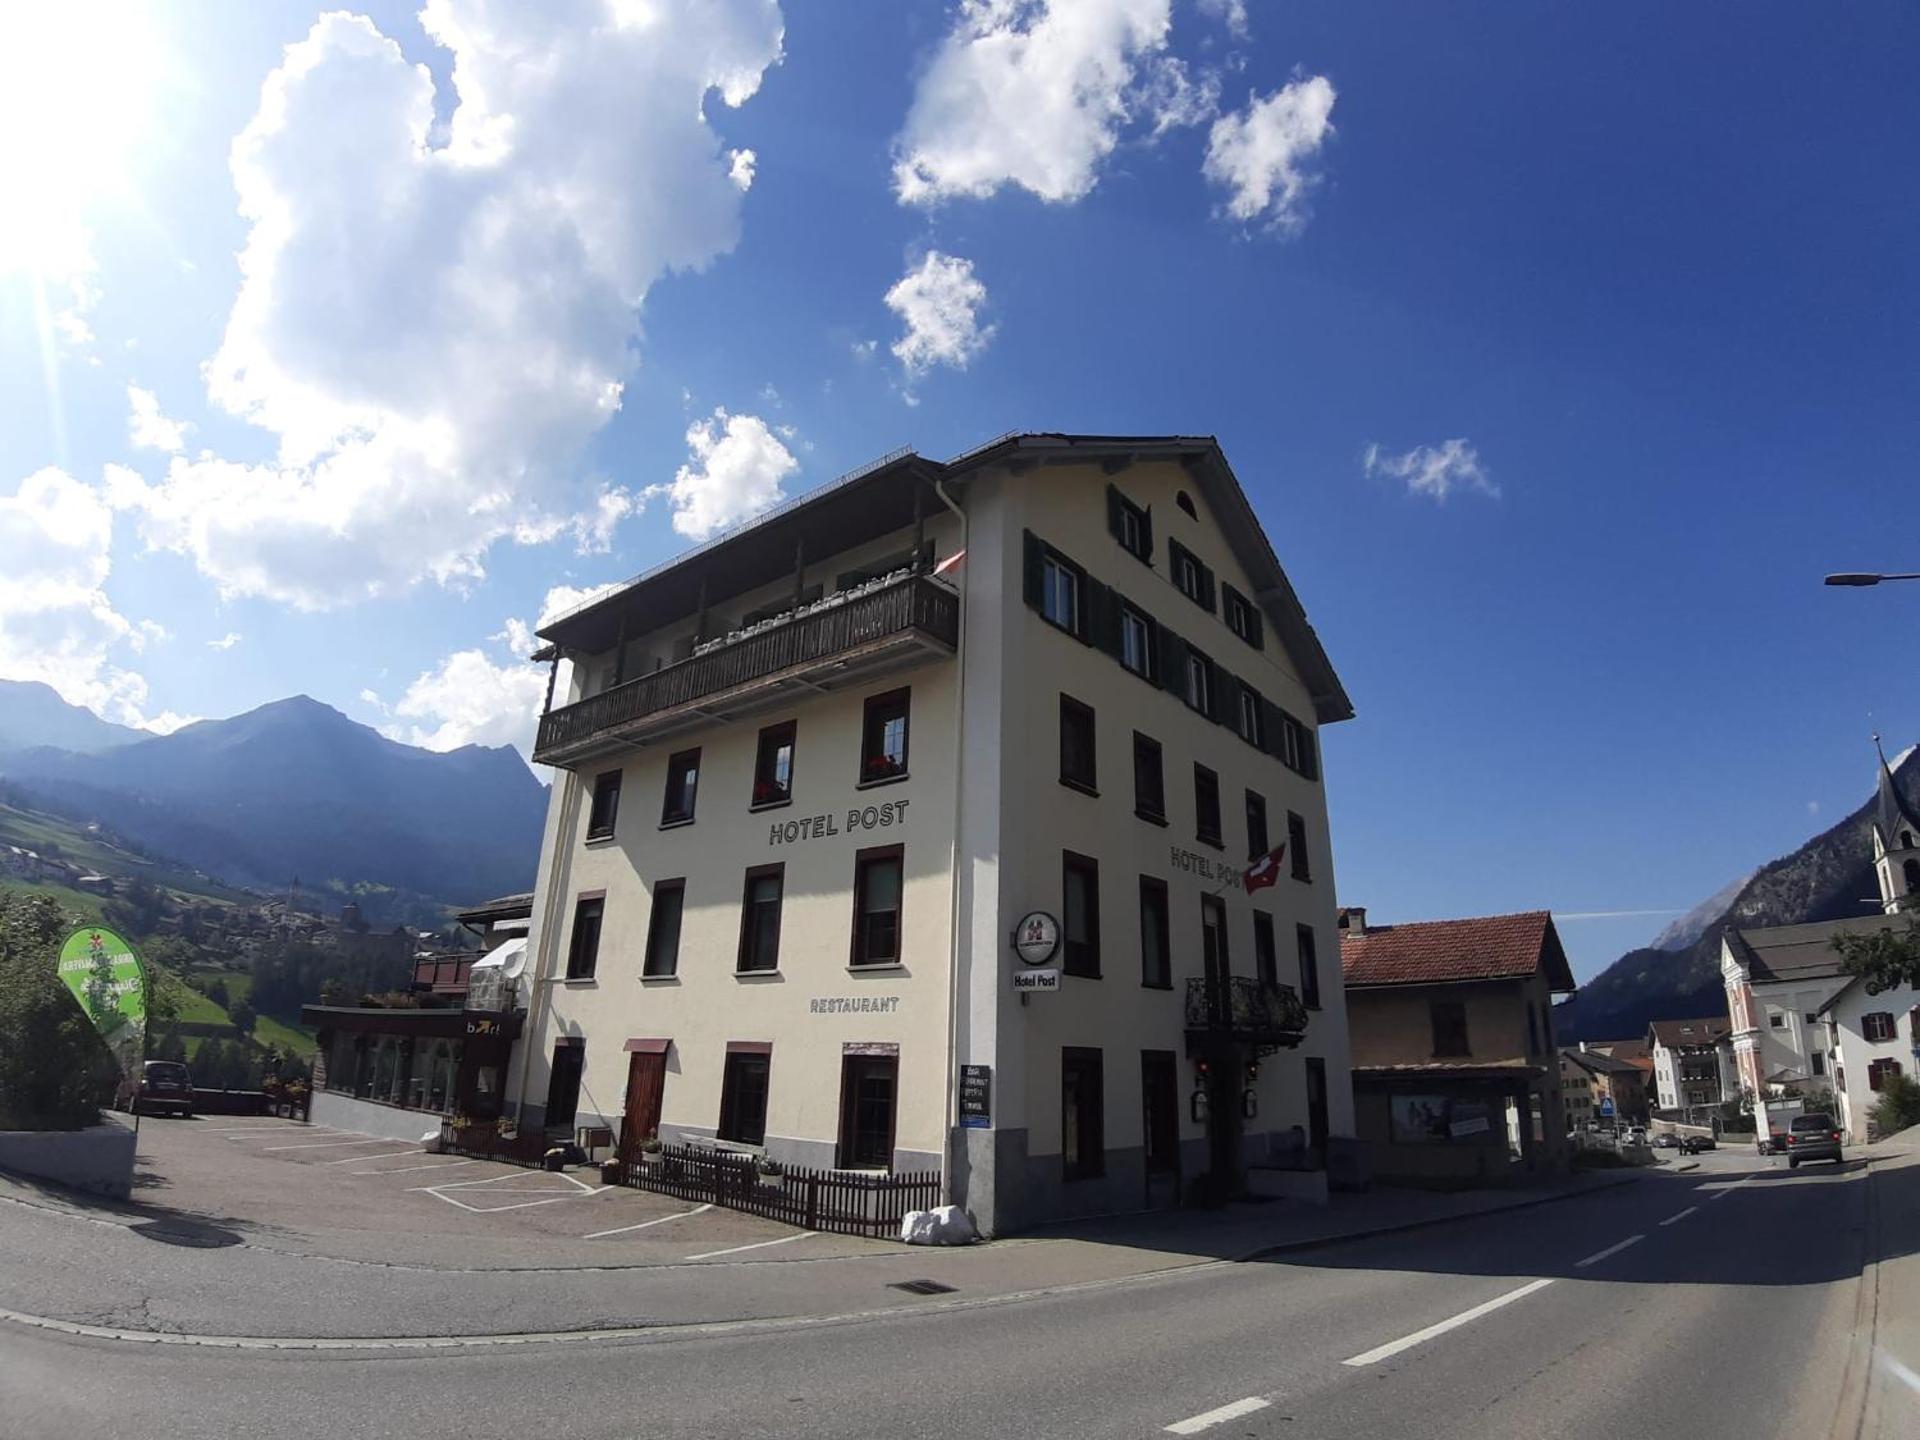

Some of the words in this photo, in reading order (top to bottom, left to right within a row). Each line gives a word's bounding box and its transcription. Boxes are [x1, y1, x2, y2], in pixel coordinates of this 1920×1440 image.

[769, 814, 838, 846] HOTEL
[847, 800, 910, 833] POST
[1170, 846, 1214, 879] HOTEL
[1217, 863, 1242, 888] POS
[1014, 974, 1035, 988] Hotel
[1037, 974, 1056, 987] Post
[810, 996, 900, 1014] RESTAURANT
